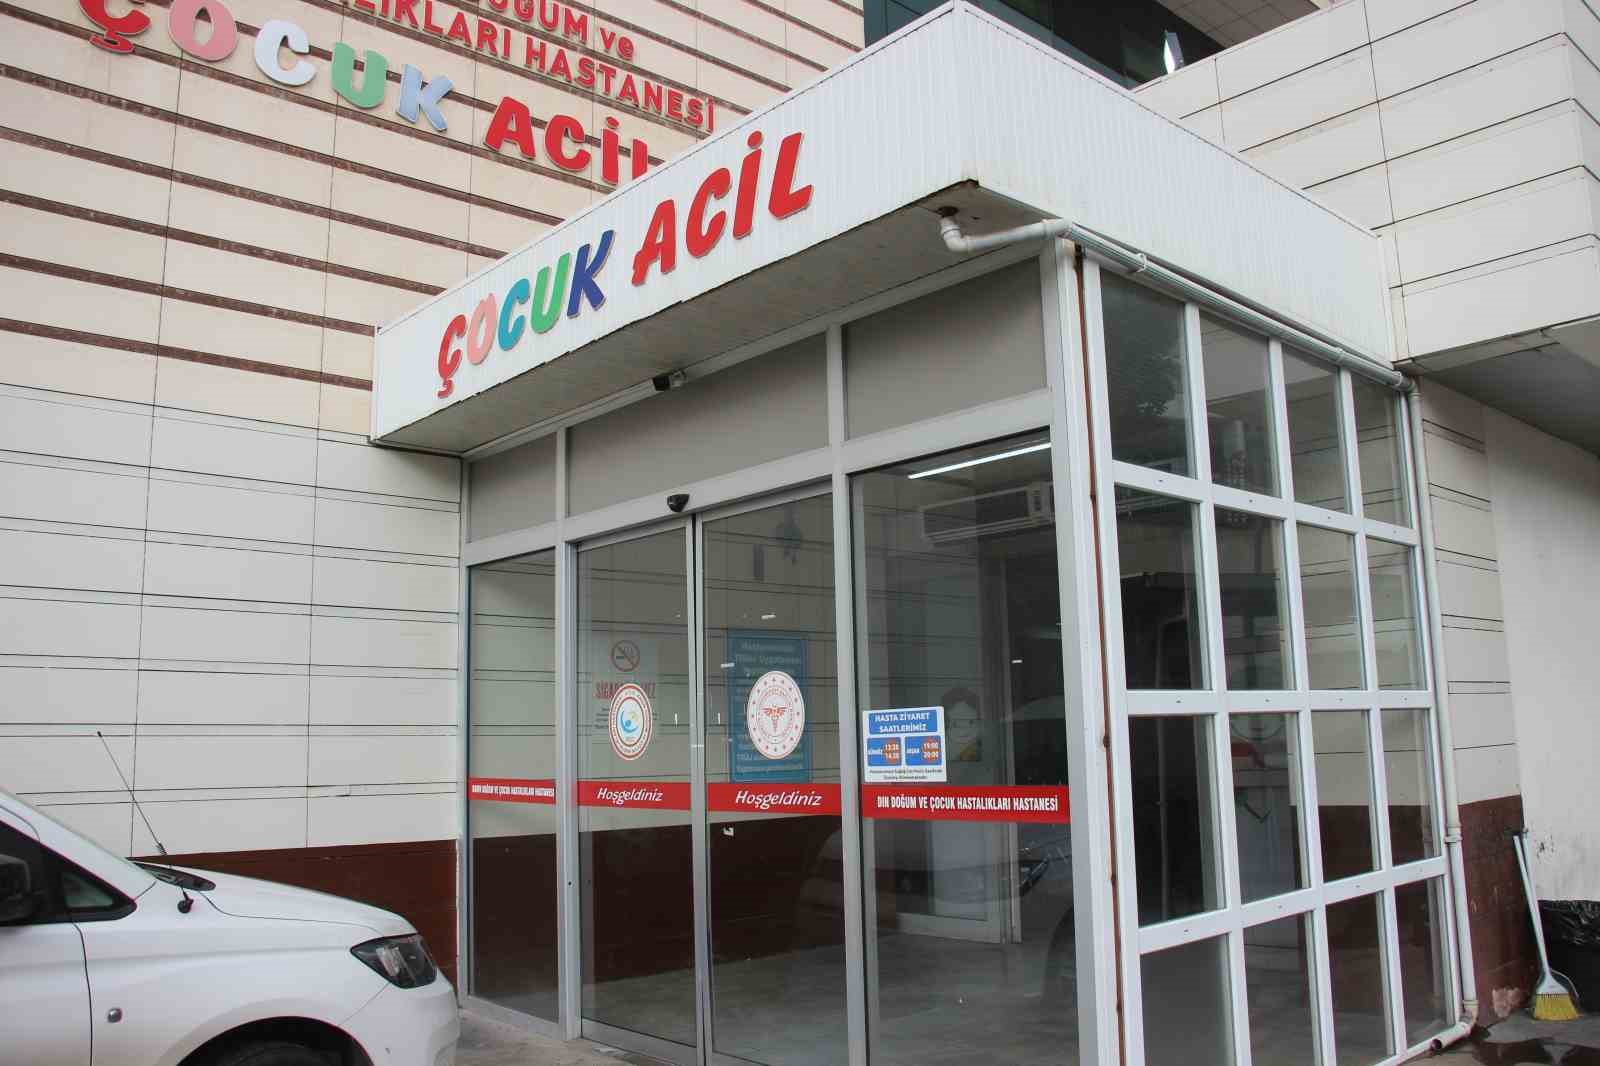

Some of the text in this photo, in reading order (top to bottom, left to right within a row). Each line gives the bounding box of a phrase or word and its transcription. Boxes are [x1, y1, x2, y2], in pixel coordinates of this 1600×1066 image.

[599, 26, 635, 61] ve
[78, 0, 455, 132] ÇOCUK
[523, 35, 715, 134] HASTANESİ
[437, 130, 814, 399] ÇOCUK ACİL
[875, 711, 929, 722] HASTA ZİYARET
[879, 722, 927, 733] SAATLERİMİZ
[596, 787, 664, 805] Hoşgeldiniz
[735, 790, 823, 810] Hoşgeldiniz
[891, 793, 917, 809] DOĞUM
[918, 796, 928, 809] VE
[929, 796, 956, 812] ÇOCUK
[956, 796, 1011, 811] HASTALIKLARI
[1012, 794, 1059, 811] HASTANESİ
